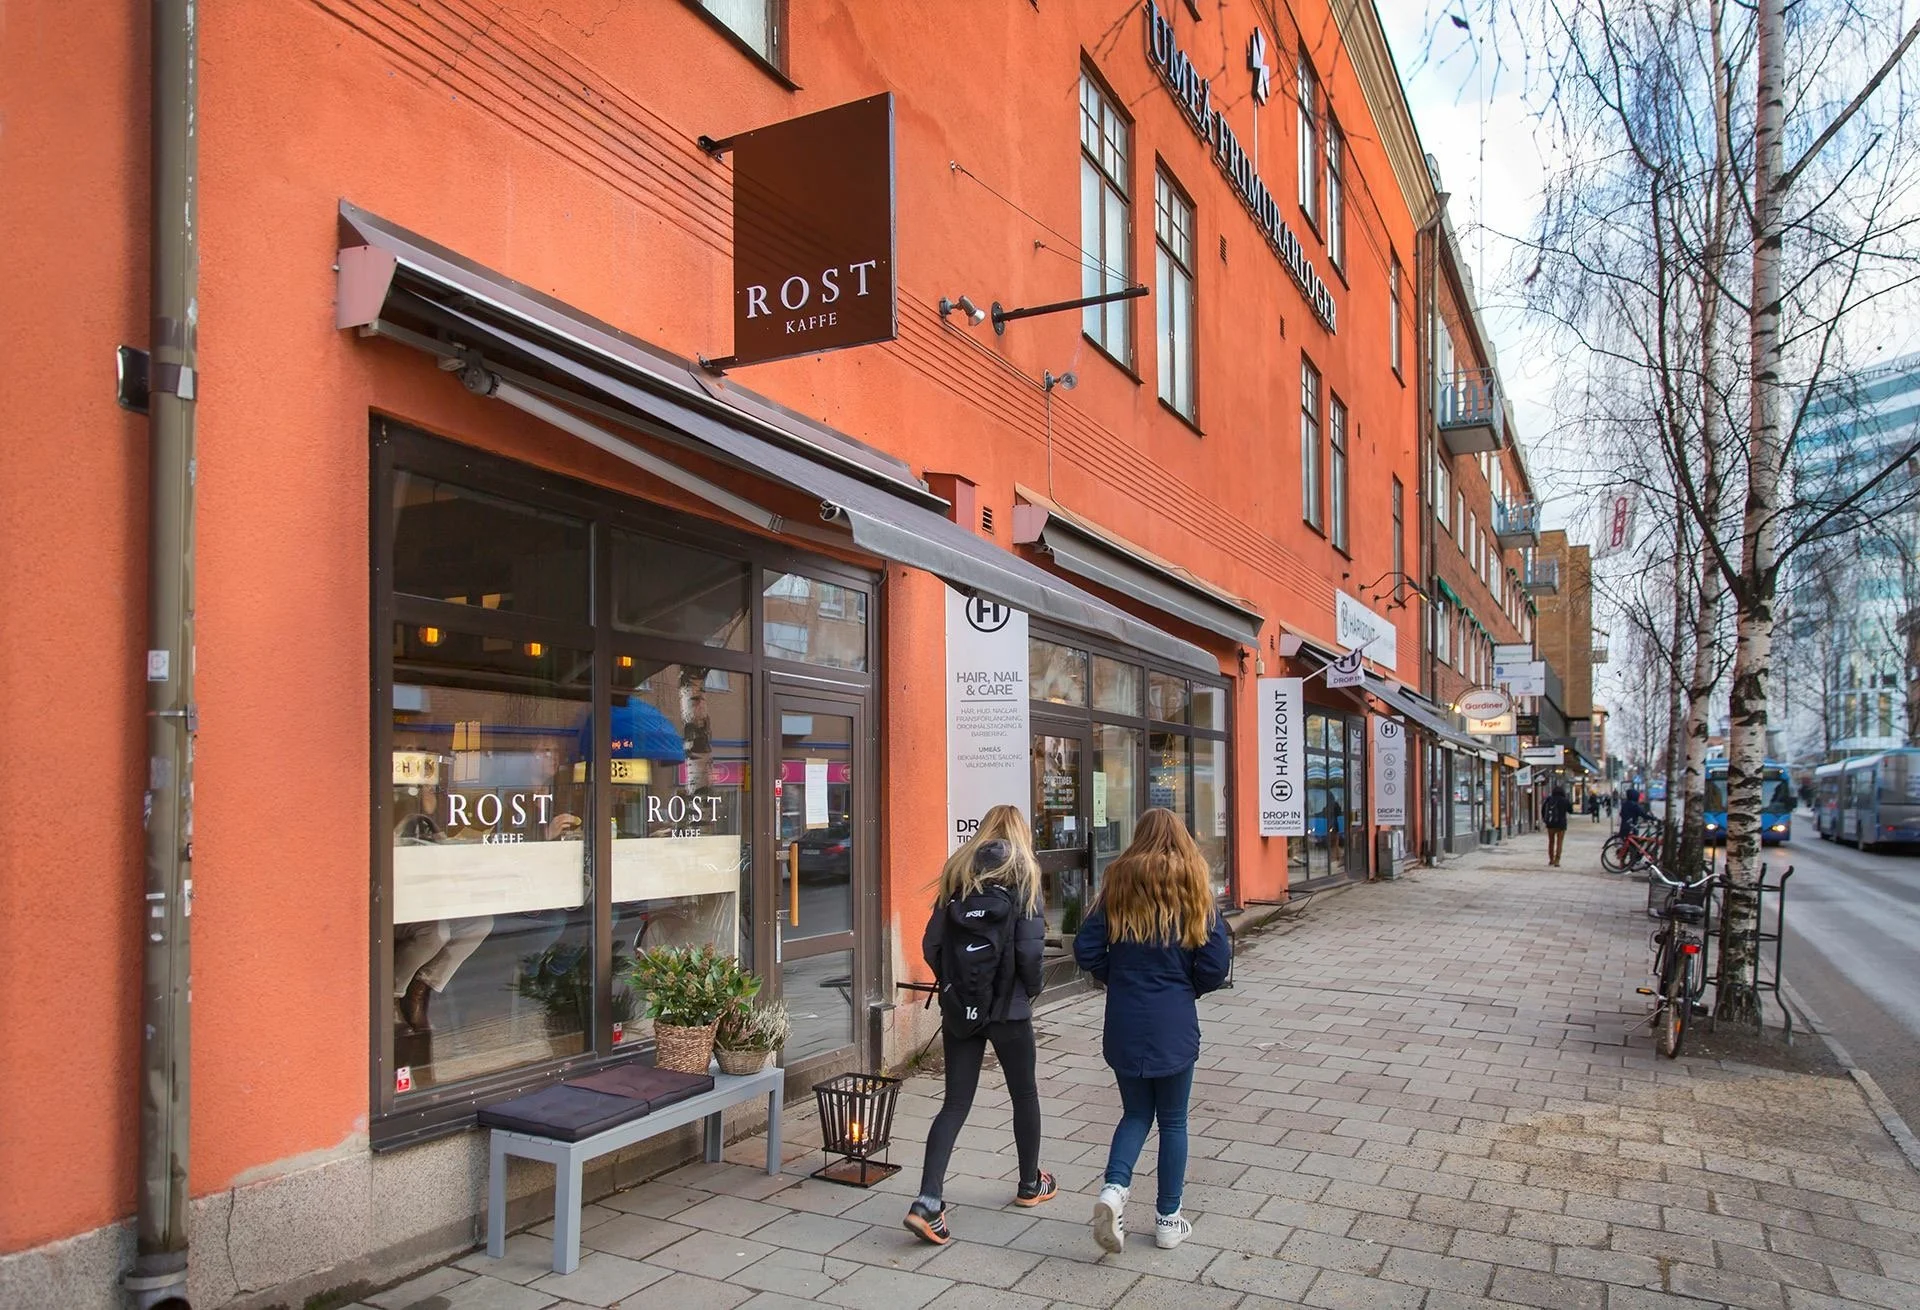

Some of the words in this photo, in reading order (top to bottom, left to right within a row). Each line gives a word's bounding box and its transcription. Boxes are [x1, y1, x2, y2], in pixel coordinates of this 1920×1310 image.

[746, 260, 876, 319] ROST
[785, 312, 837, 334] KAFFE
[956, 671, 991, 684] HAIR,
[993, 671, 1023, 682] NAIL
[1333, 676, 1354, 684] DROP
[966, 685, 975, 696] &
[978, 684, 1013, 696] CARE
[1465, 702, 1503, 710] Gardiner
[1273, 690, 1288, 776] HÅRIZONT
[447, 793, 553, 826] ROST
[646, 795, 722, 823] ROST
[1262, 811, 1290, 819] DROP
[1290, 811, 1301, 819] IN
[956, 819, 980, 832] DR
[966, 1006, 978, 1020] 16
